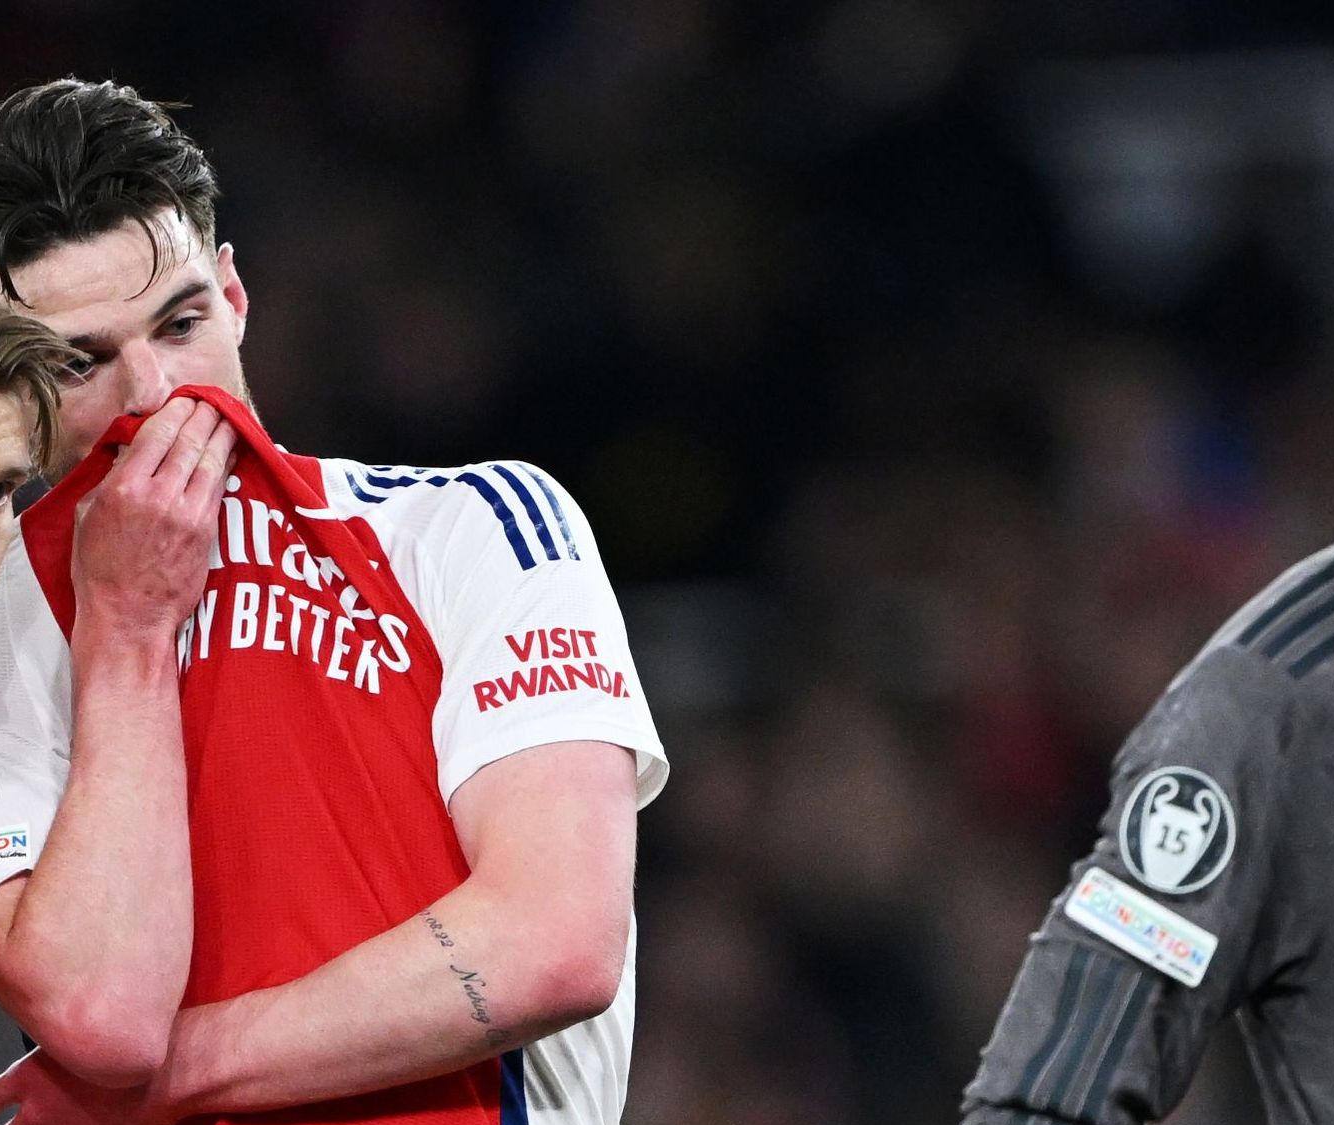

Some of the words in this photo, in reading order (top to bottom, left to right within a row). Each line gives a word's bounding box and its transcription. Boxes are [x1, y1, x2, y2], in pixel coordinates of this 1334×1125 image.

[230, 582, 380, 695] BETTER
[505, 627, 598, 662] VISIT
[473, 662, 631, 712] RWANDA
[1157, 825, 1188, 854] 15
